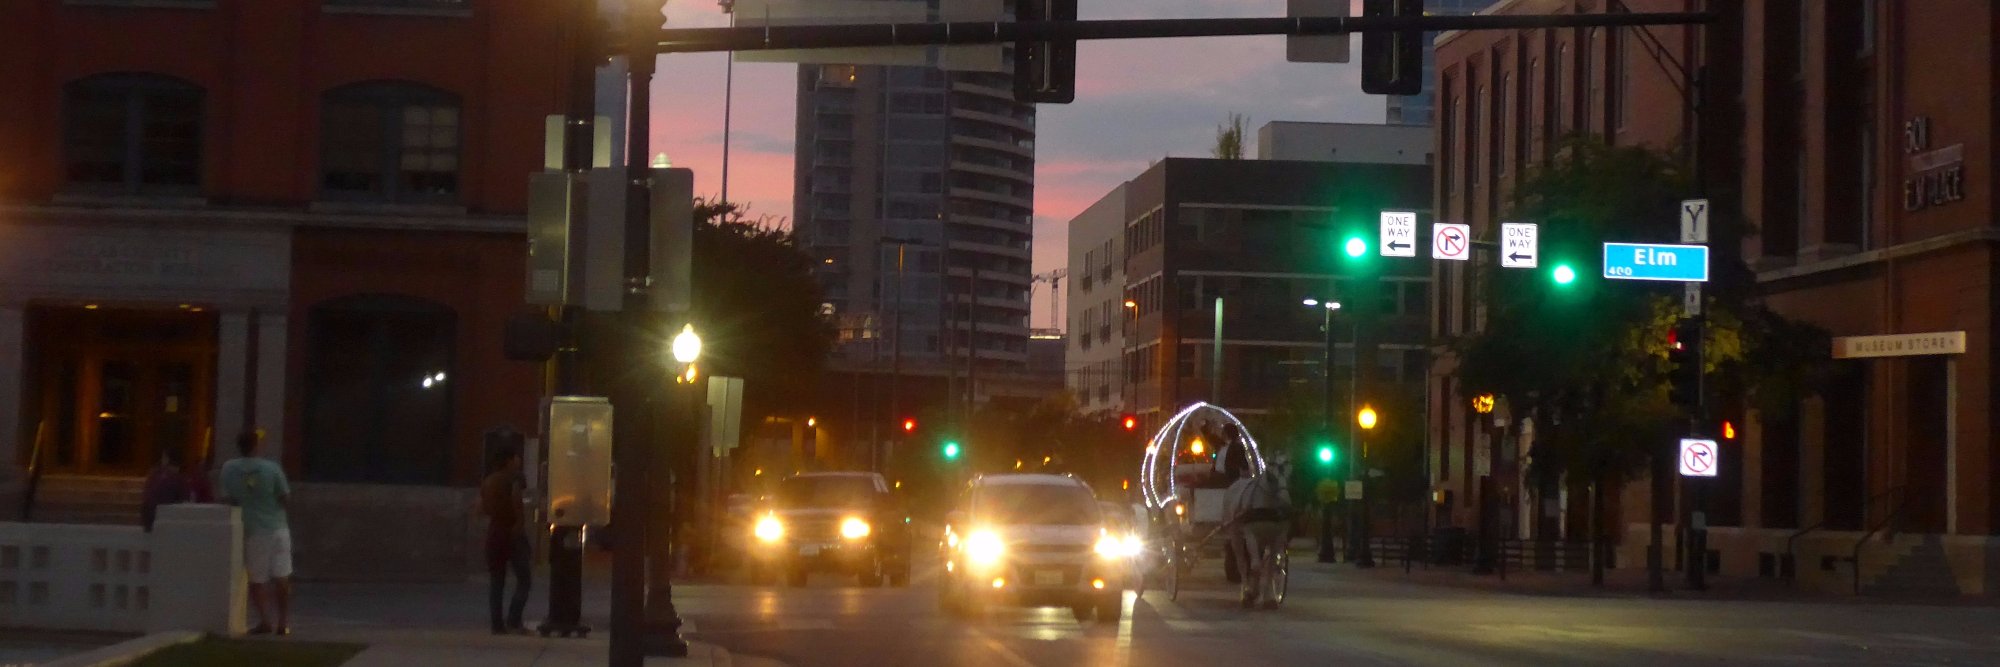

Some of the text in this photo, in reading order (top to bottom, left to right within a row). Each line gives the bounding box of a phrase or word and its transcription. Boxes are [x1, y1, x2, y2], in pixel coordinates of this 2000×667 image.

[1387, 216, 1409, 226] ONE
[1388, 227, 1410, 237] WAY
[1509, 228, 1530, 237] ONE
[1509, 239, 1530, 248] WAY
[1634, 248, 1677, 266] Elm
[1608, 267, 1633, 276] 400
[1855, 341, 1902, 352] MUSEUM
